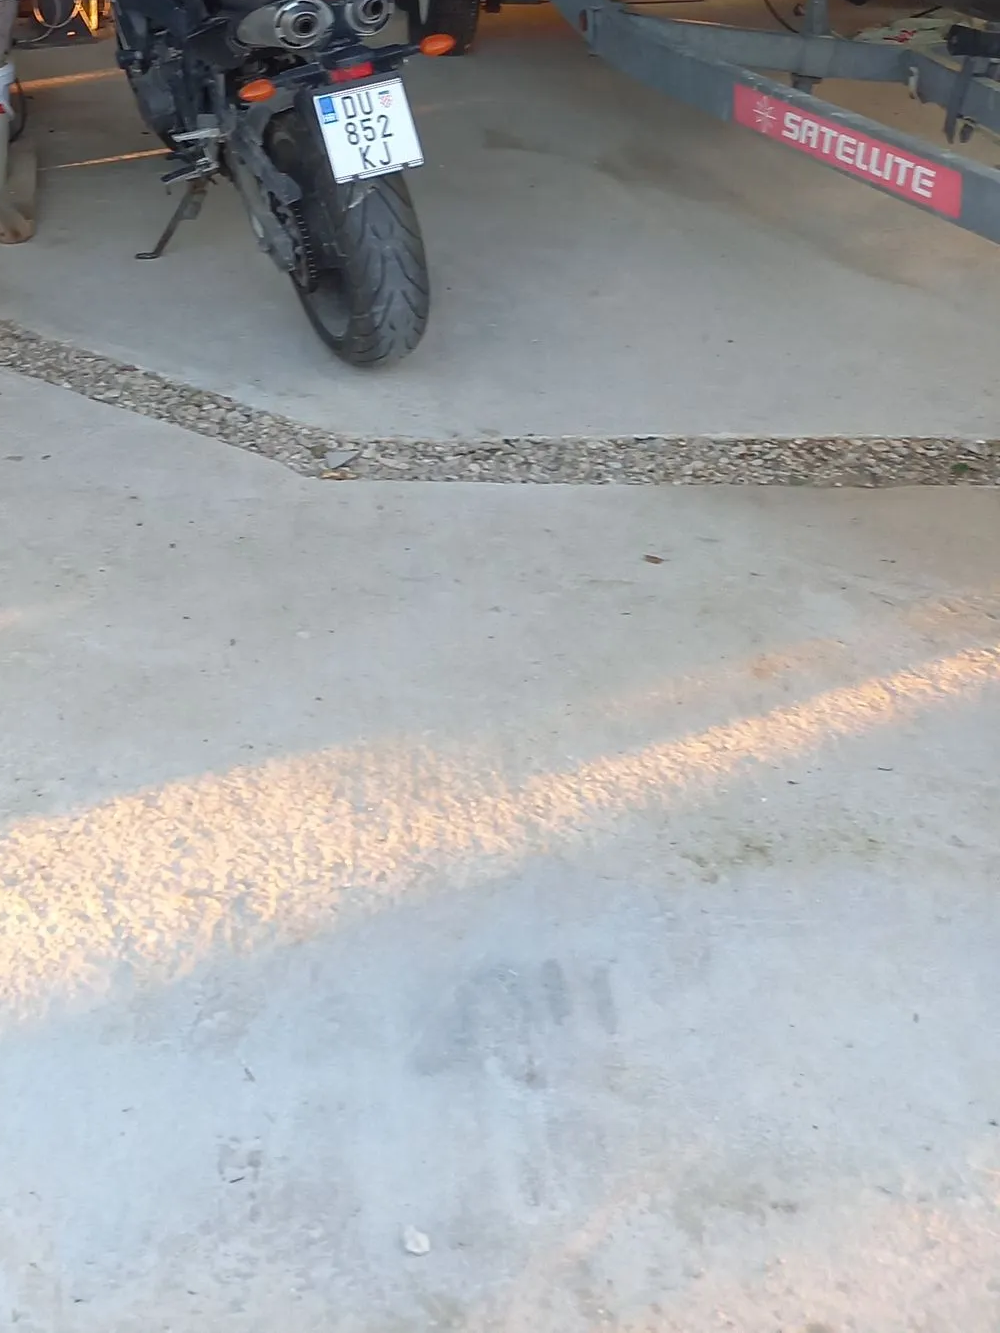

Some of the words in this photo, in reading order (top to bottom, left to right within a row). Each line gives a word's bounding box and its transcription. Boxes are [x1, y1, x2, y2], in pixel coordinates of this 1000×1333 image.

[341, 92, 374, 119] DU
[345, 114, 393, 145] 852
[359, 141, 392, 170] KJ
[782, 112, 937, 198] SATELLITE
